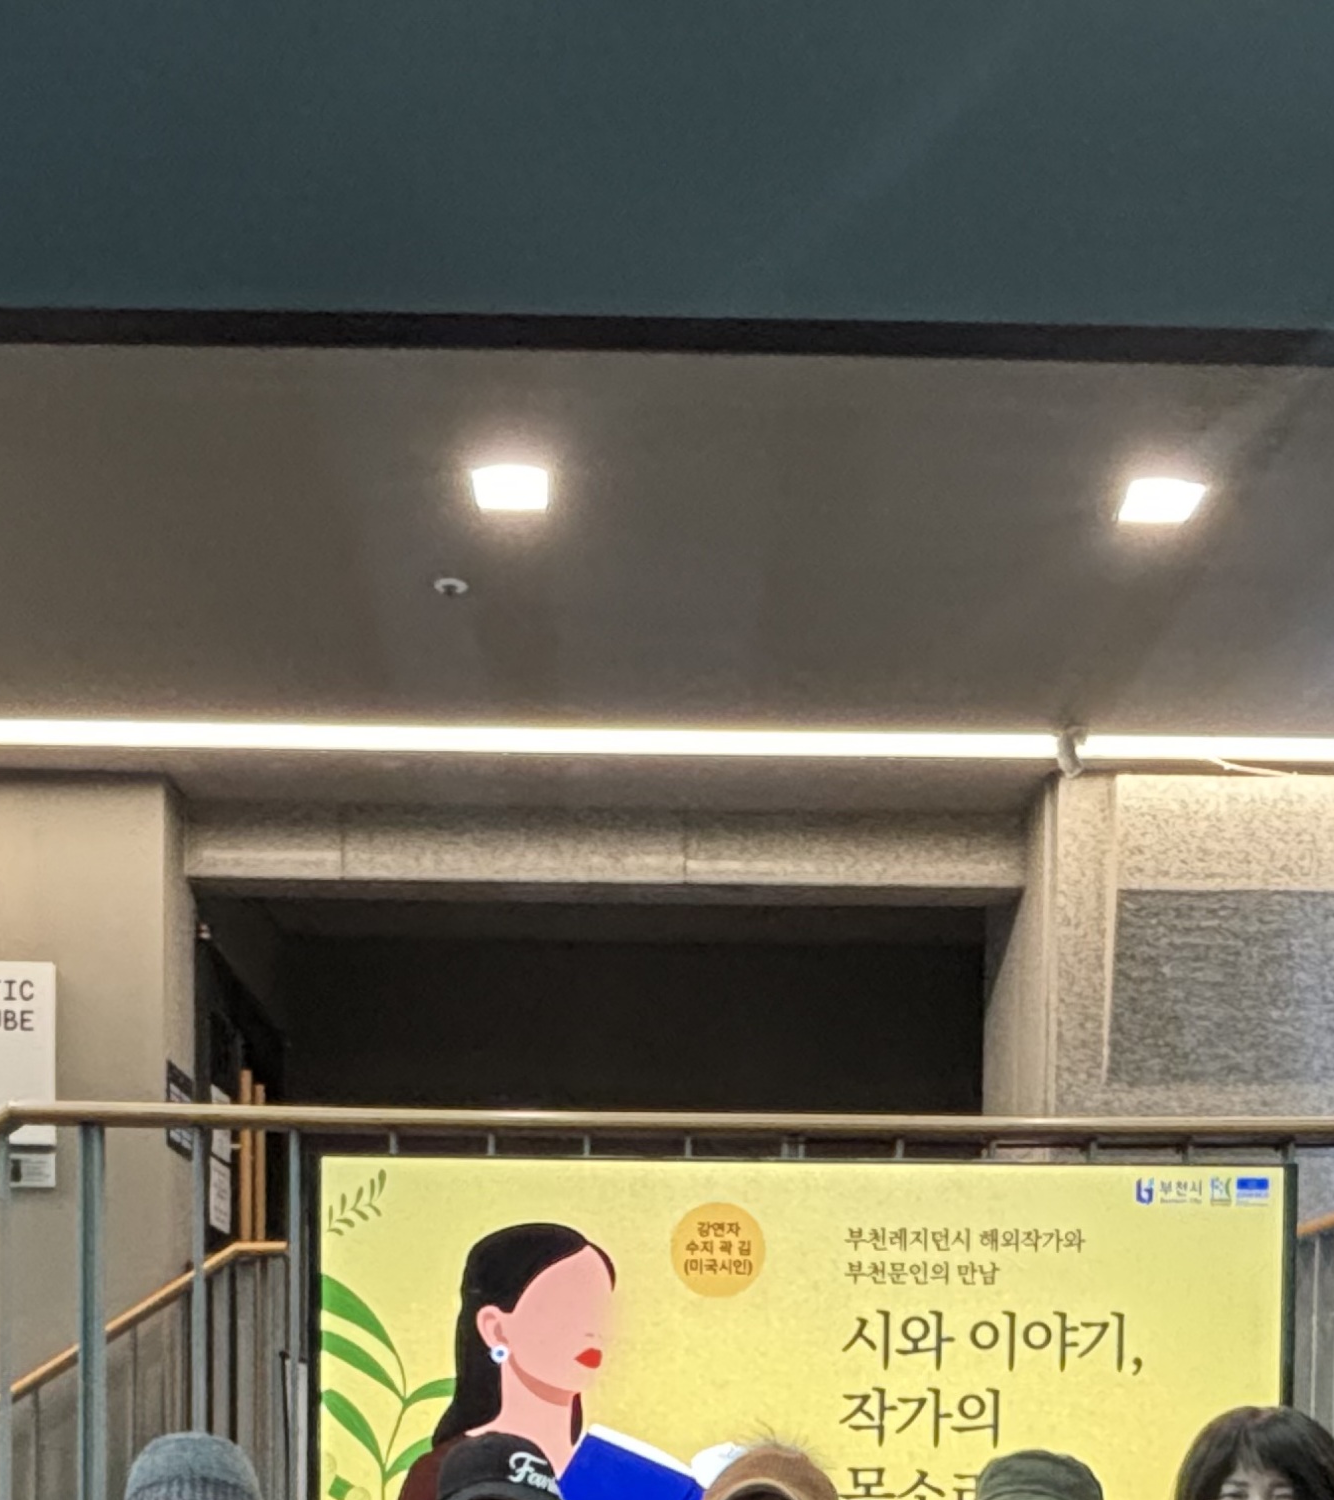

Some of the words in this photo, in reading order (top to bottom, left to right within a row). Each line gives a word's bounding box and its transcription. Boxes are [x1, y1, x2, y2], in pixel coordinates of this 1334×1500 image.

[1160, 1179, 1202, 1196] 부천시
[697, 1221, 741, 1238] 강연자
[844, 1227, 971, 1252] 부천레지던시
[979, 1228, 1086, 1253] 해외작가와
[685, 1240, 714, 1256] 수지
[738, 1240, 752, 1256] 김
[683, 1258, 753, 1276] (미국시인)
[844, 1261, 950, 1285] 부천문인의
[957, 1263, 1000, 1285] 만남
[842, 1309, 955, 1371] 시와
[969, 1310, 1143, 1375] 이야기,
[839, 1387, 1000, 1448] 작가의
